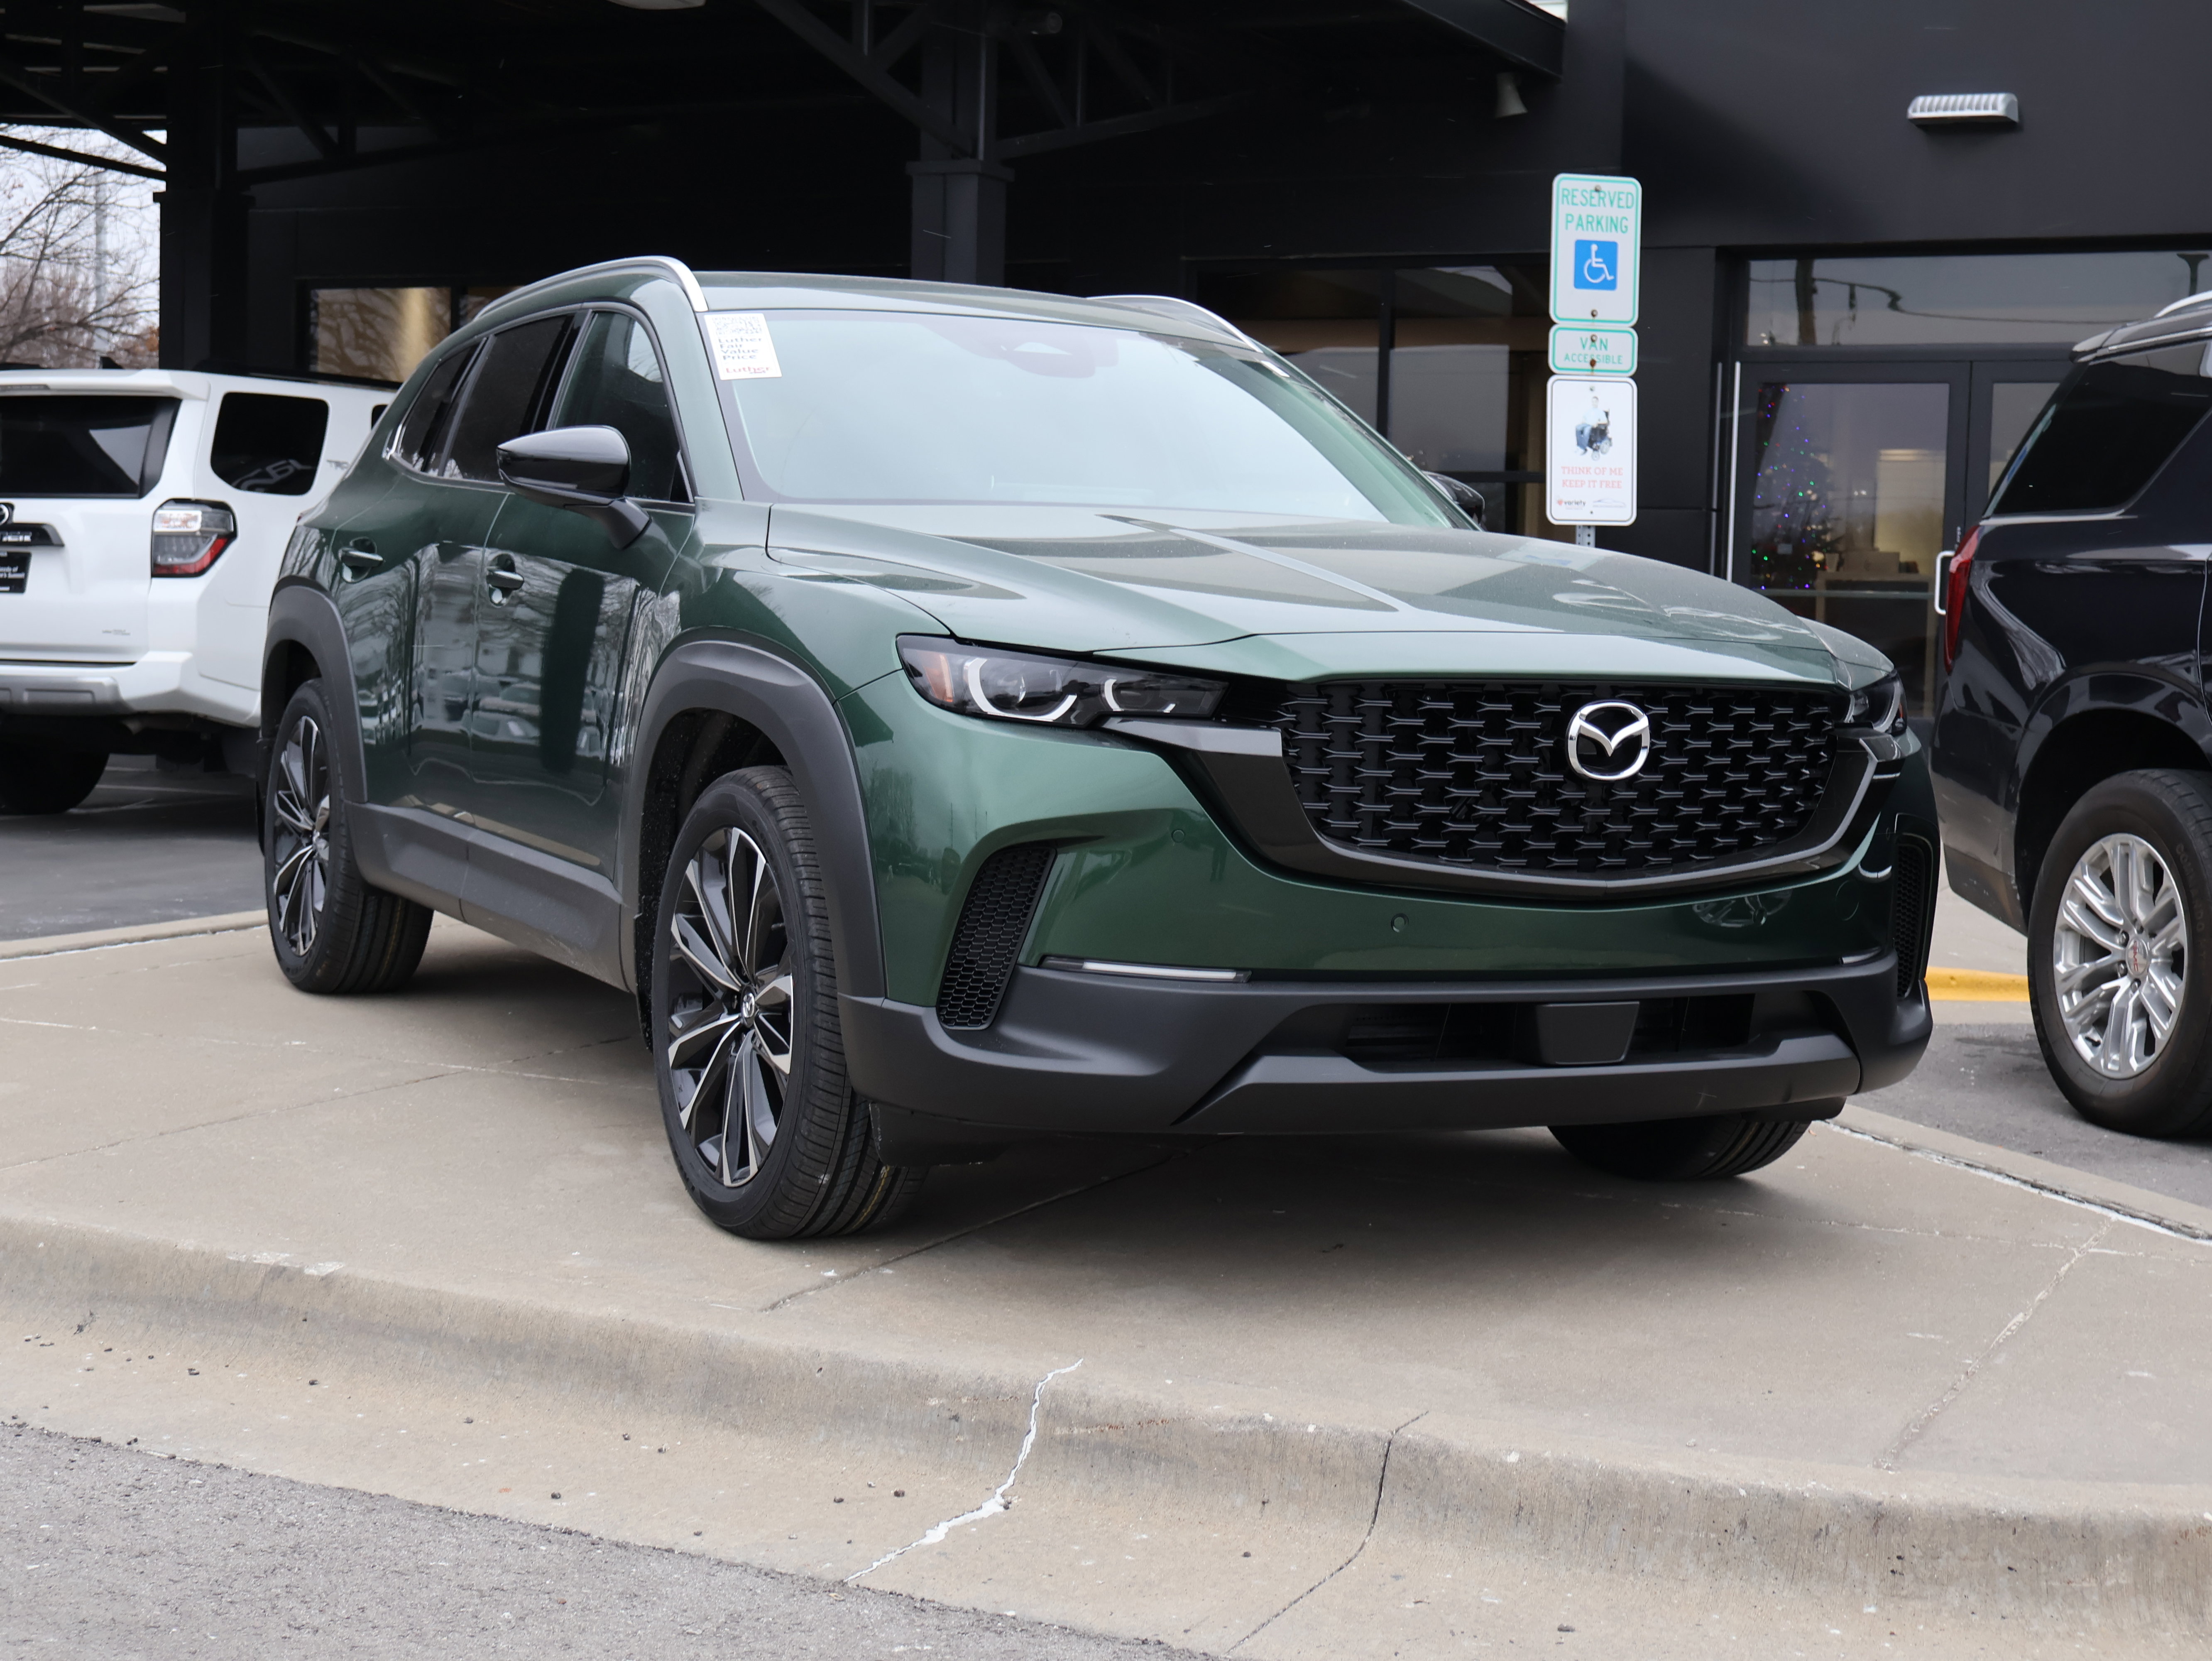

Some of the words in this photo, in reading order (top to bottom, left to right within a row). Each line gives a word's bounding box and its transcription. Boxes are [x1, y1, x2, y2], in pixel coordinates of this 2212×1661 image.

[1561, 188, 1635, 208] RESERVED
[1565, 213, 1629, 234] PARKING
[1580, 337, 1608, 351] VAN
[1564, 353, 1623, 365] ACCESSIBLE
[1561, 466, 1592, 475] THINK
[1594, 467, 1607, 475] OF
[1609, 467, 1623, 476] ME
[1562, 479, 1586, 488] KEEP
[1588, 480, 1598, 488] IT
[1600, 480, 1622, 489] FREE
